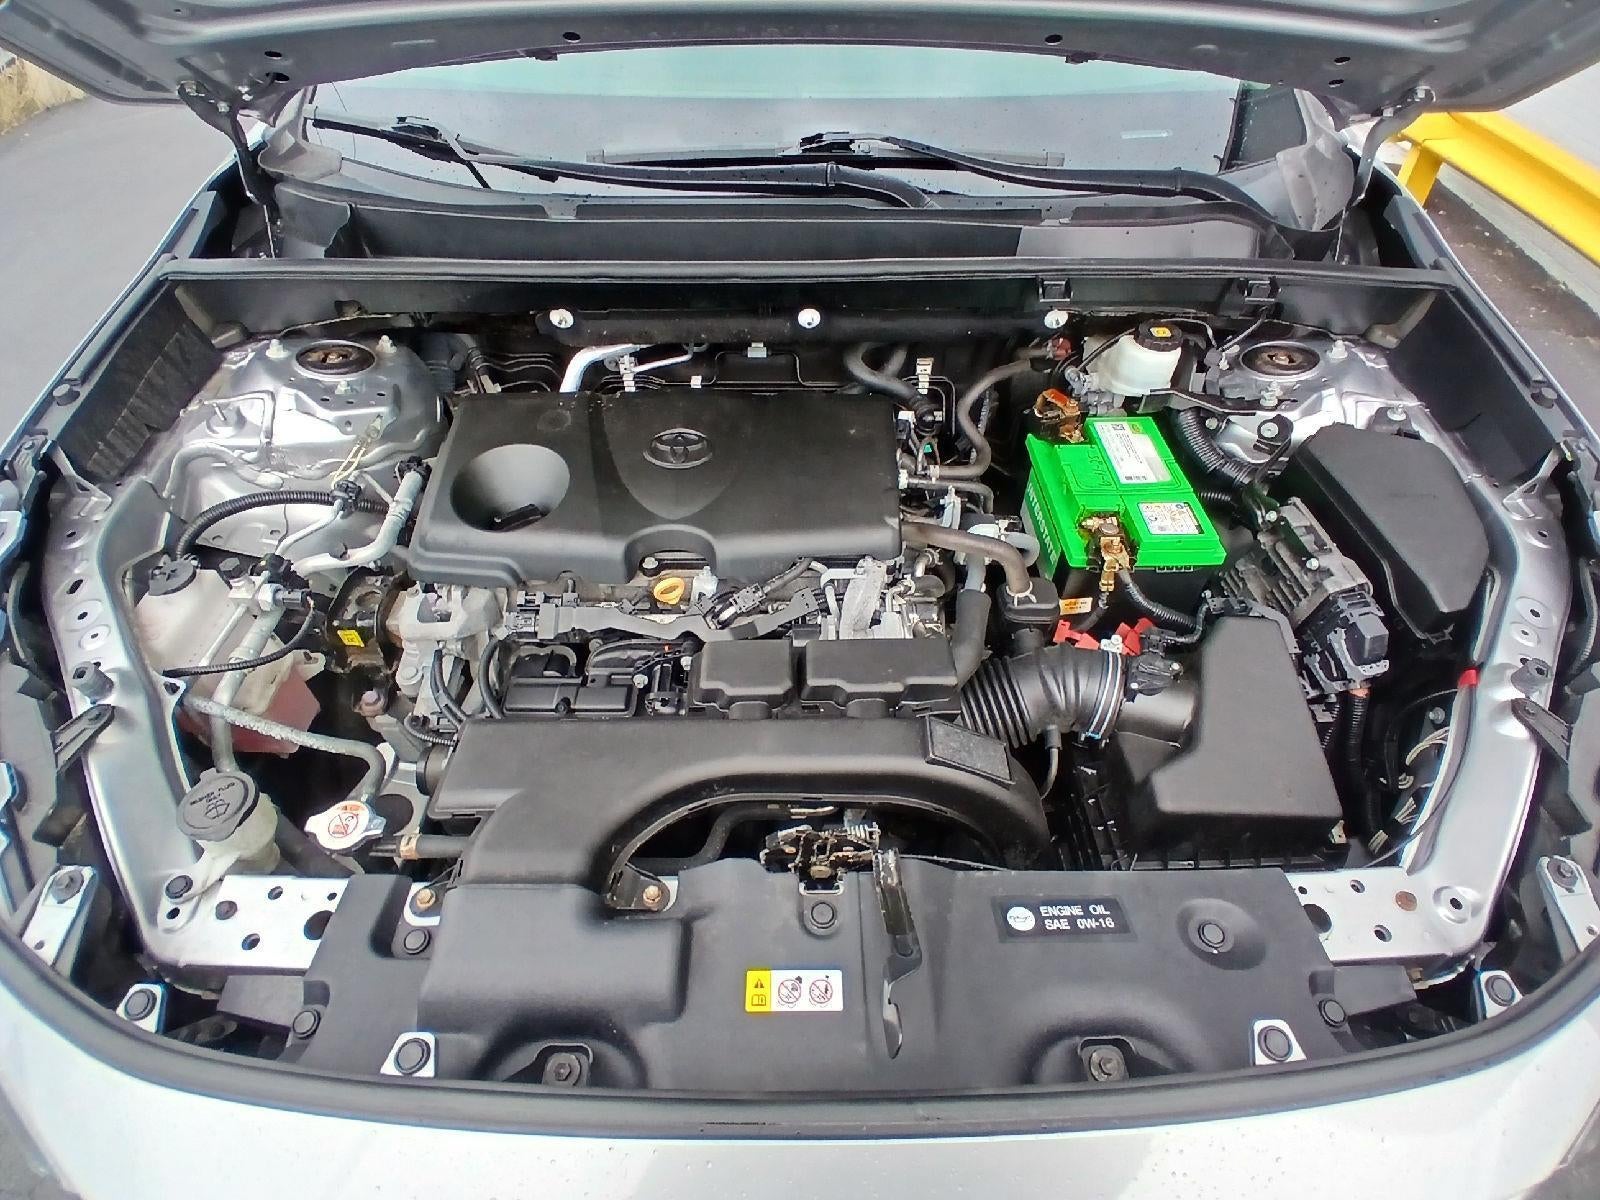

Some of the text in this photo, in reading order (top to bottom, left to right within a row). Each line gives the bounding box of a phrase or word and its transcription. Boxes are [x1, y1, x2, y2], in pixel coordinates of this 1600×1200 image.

[1027, 481, 1057, 565] INTERSTATE
[1040, 904, 1110, 917] ENGINE OIL
[1044, 917, 1115, 930] SAE 0W-16
